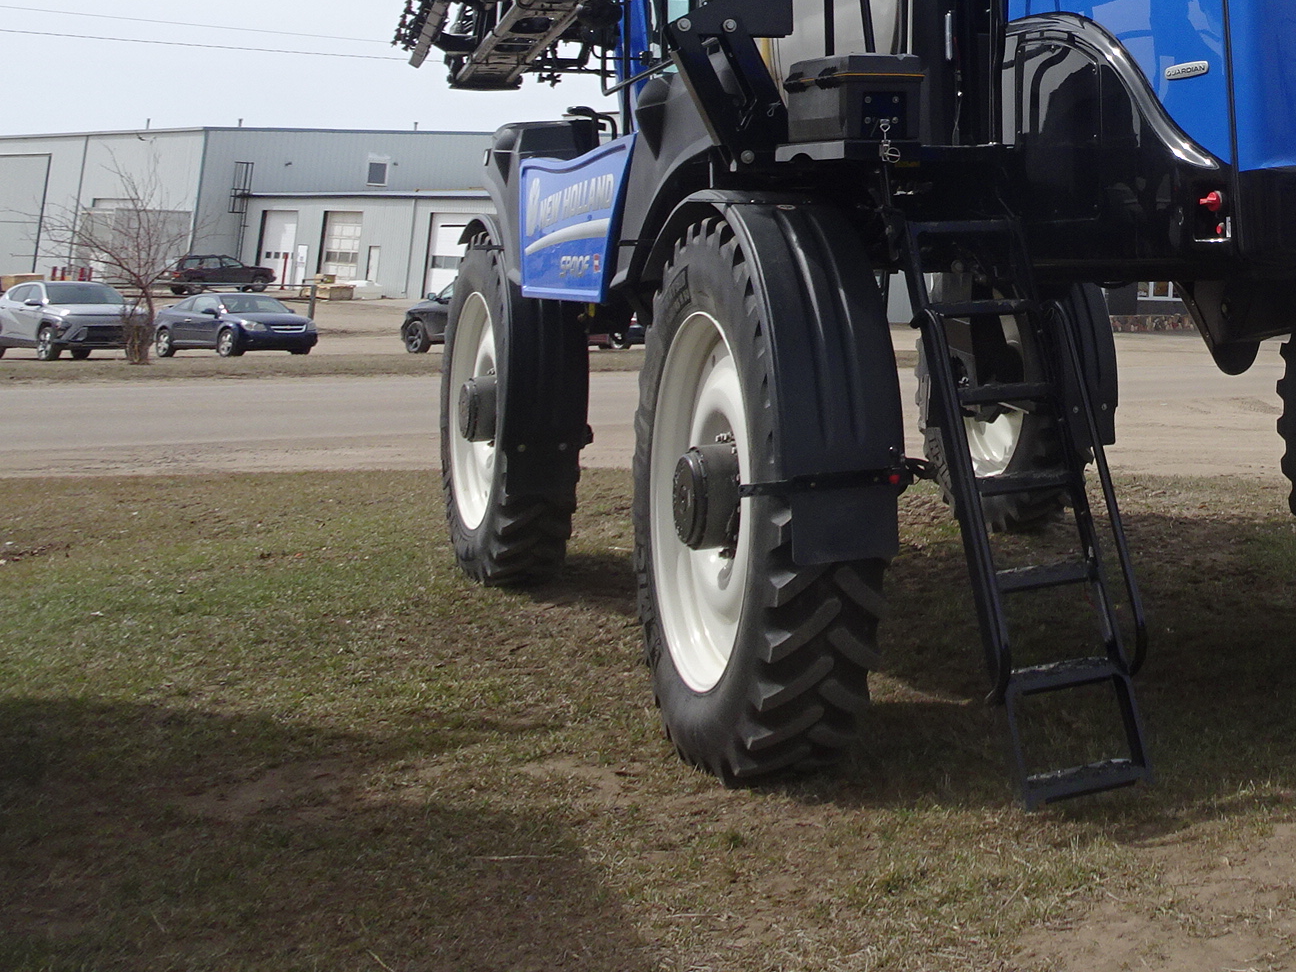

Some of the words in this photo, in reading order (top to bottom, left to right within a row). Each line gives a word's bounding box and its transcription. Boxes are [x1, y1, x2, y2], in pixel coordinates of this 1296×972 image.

[1166, 64, 1206, 77] GUARDIAN
[539, 190, 562, 229] NEW
[562, 173, 614, 219] HOLLAND
